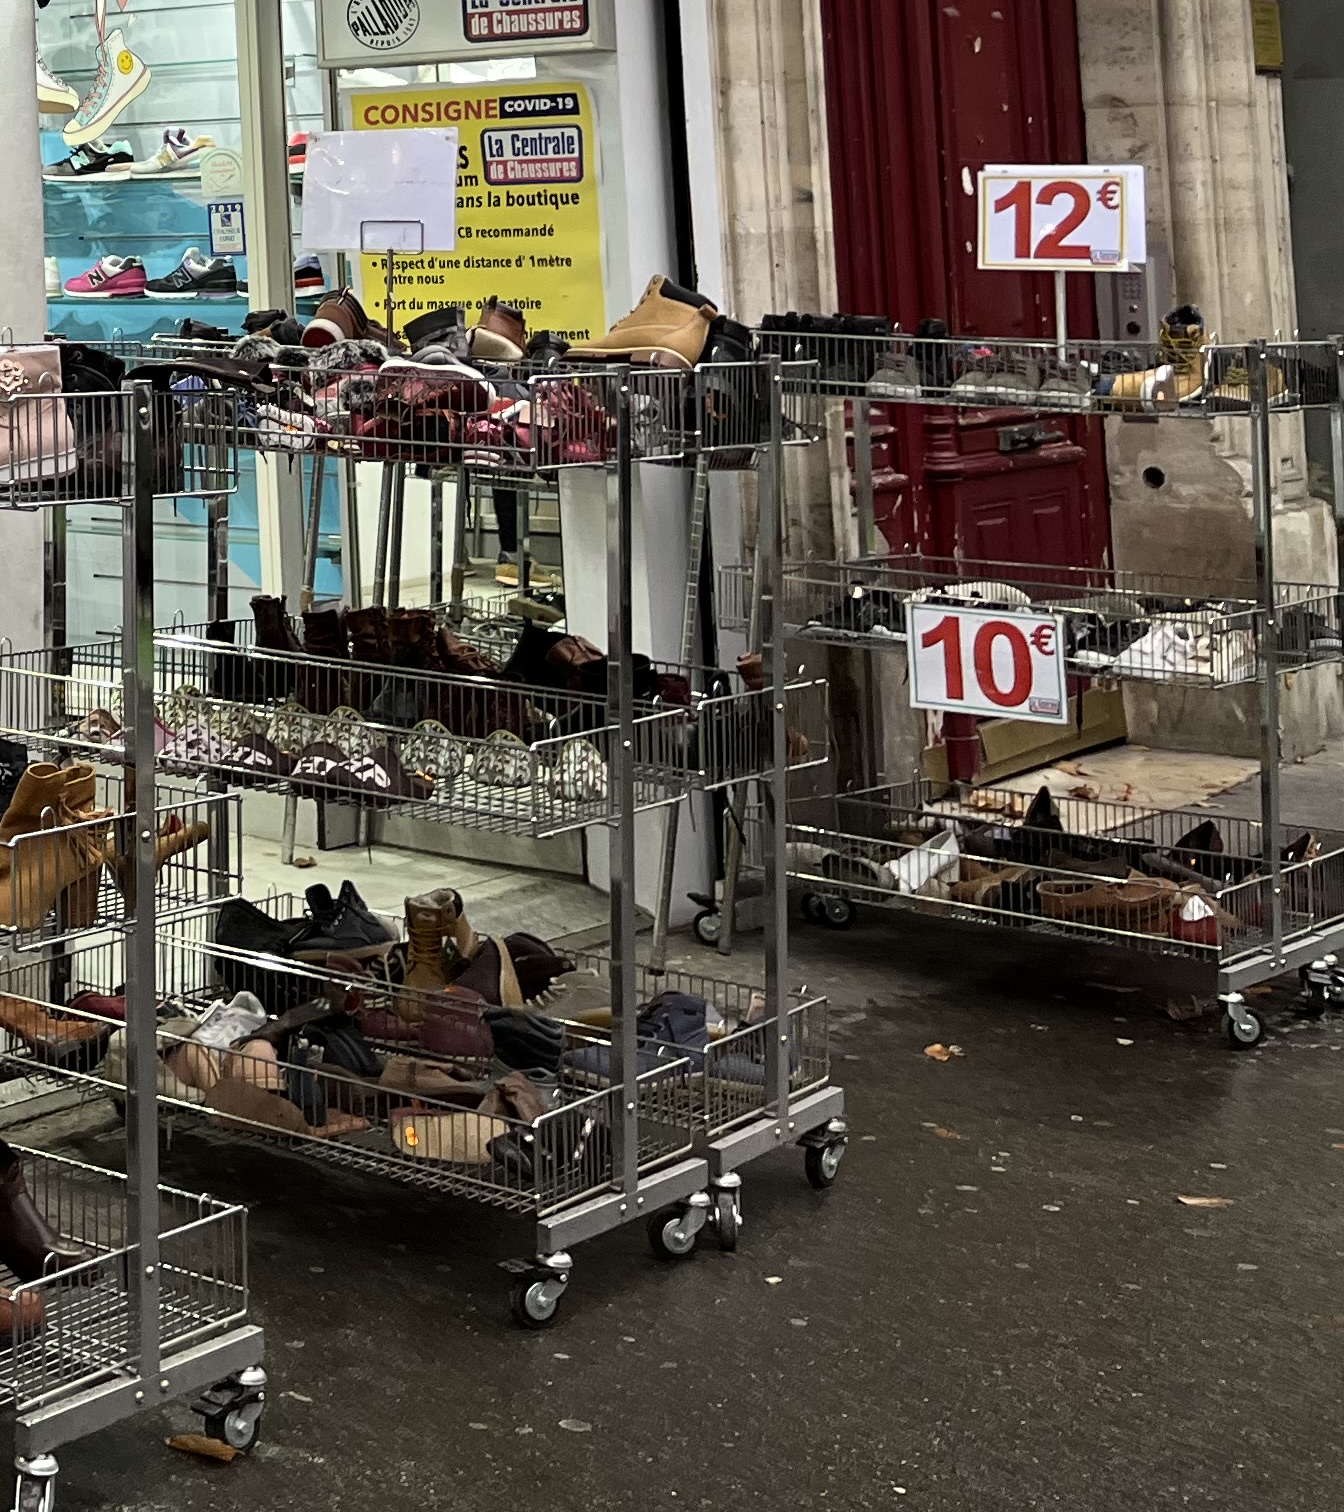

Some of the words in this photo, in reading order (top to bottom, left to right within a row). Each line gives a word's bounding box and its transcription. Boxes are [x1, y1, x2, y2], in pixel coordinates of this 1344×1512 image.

[471, 15, 489, 36] de
[492, 10, 581, 34] Chaussures
[364, 98, 499, 126] CONSIGNE
[504, 96, 574, 113] COVID-19
[487, 135, 504, 159] La
[511, 131, 576, 157] Centrale
[456, 144, 470, 170] S
[490, 163, 505, 180] de
[507, 158, 578, 179] Chaussures
[210, 204, 242, 213] 2019
[487, 190, 500, 208] la
[506, 188, 580, 210] boutique
[458, 226, 473, 238] CB
[475, 223, 555, 238] recommandé
[994, 181, 1120, 259] 12€
[381, 257, 426, 271] Rspect
[428, 255, 461, 269] d'une
[464, 255, 512, 269] distance
[515, 254, 526, 268] d'
[529, 254, 572, 268] 1mètre
[417, 274, 445, 285] nous
[409, 297, 424, 310] du
[427, 299, 473, 311] masque
[922, 615, 1056, 708] 10€
